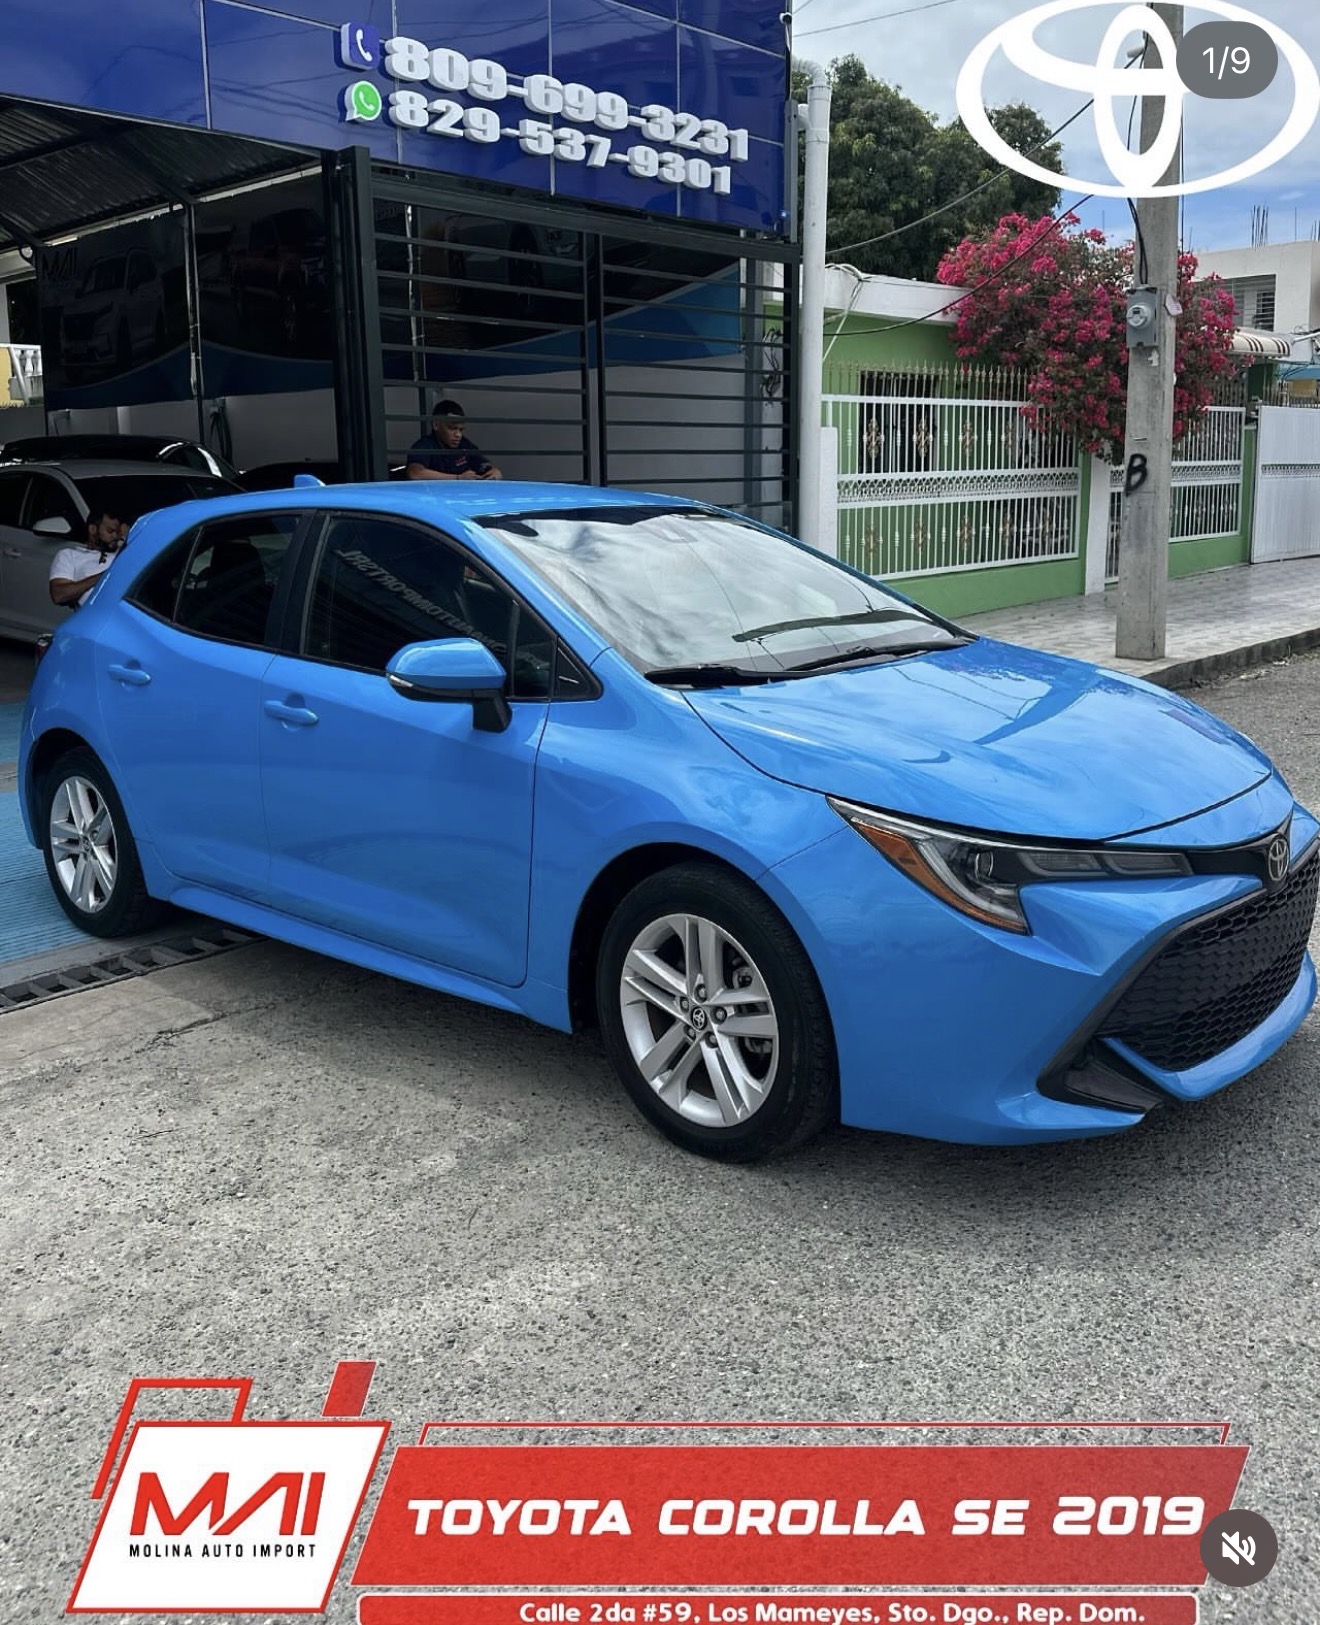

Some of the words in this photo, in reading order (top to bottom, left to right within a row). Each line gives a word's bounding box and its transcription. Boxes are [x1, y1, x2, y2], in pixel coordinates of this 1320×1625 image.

[385, 36, 748, 162] 809-699-3231
[388, 90, 731, 195] 829-537-9301
[1124, 453, 1148, 497] B
